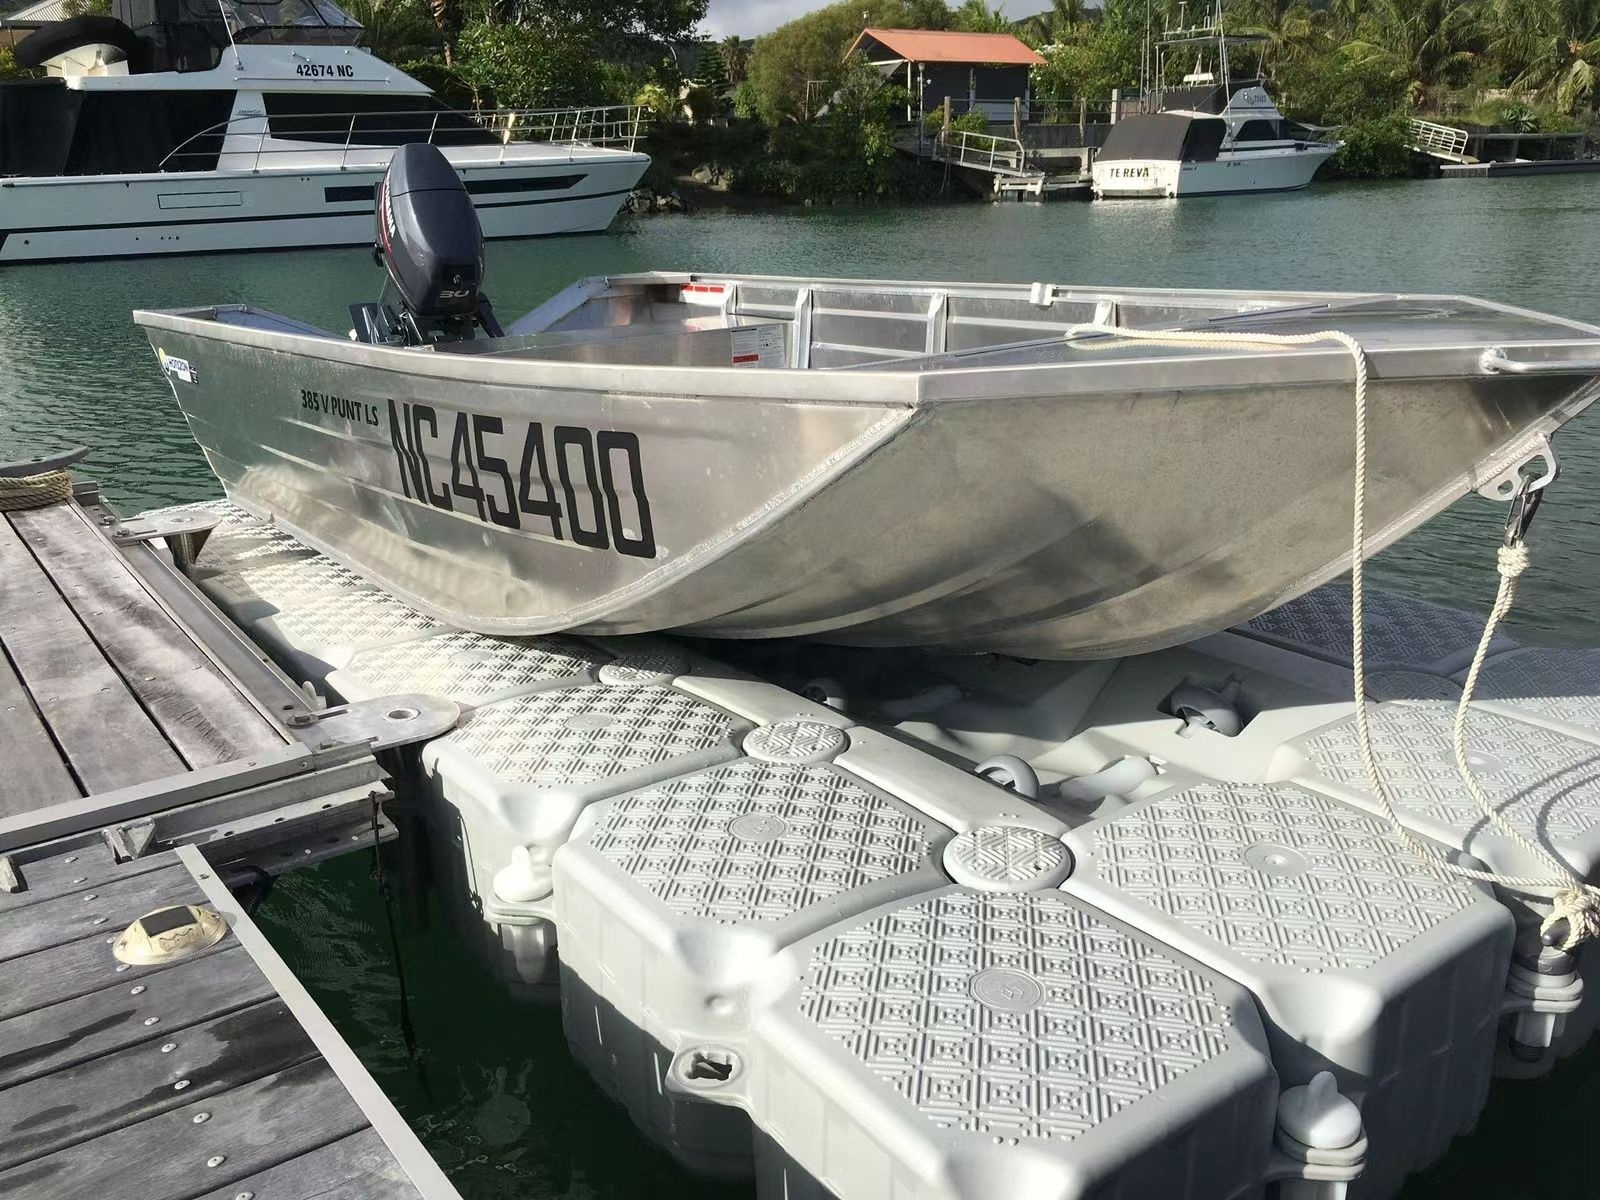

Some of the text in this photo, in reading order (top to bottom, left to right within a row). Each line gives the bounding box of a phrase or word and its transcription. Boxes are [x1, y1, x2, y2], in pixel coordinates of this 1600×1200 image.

[297, 64, 354, 77] 42674 NC
[1109, 167, 1150, 178] TE REVA
[440, 290, 470, 298] 30
[301, 389, 379, 426] 385 V PUNT LS
[387, 399, 657, 559] NC45400
